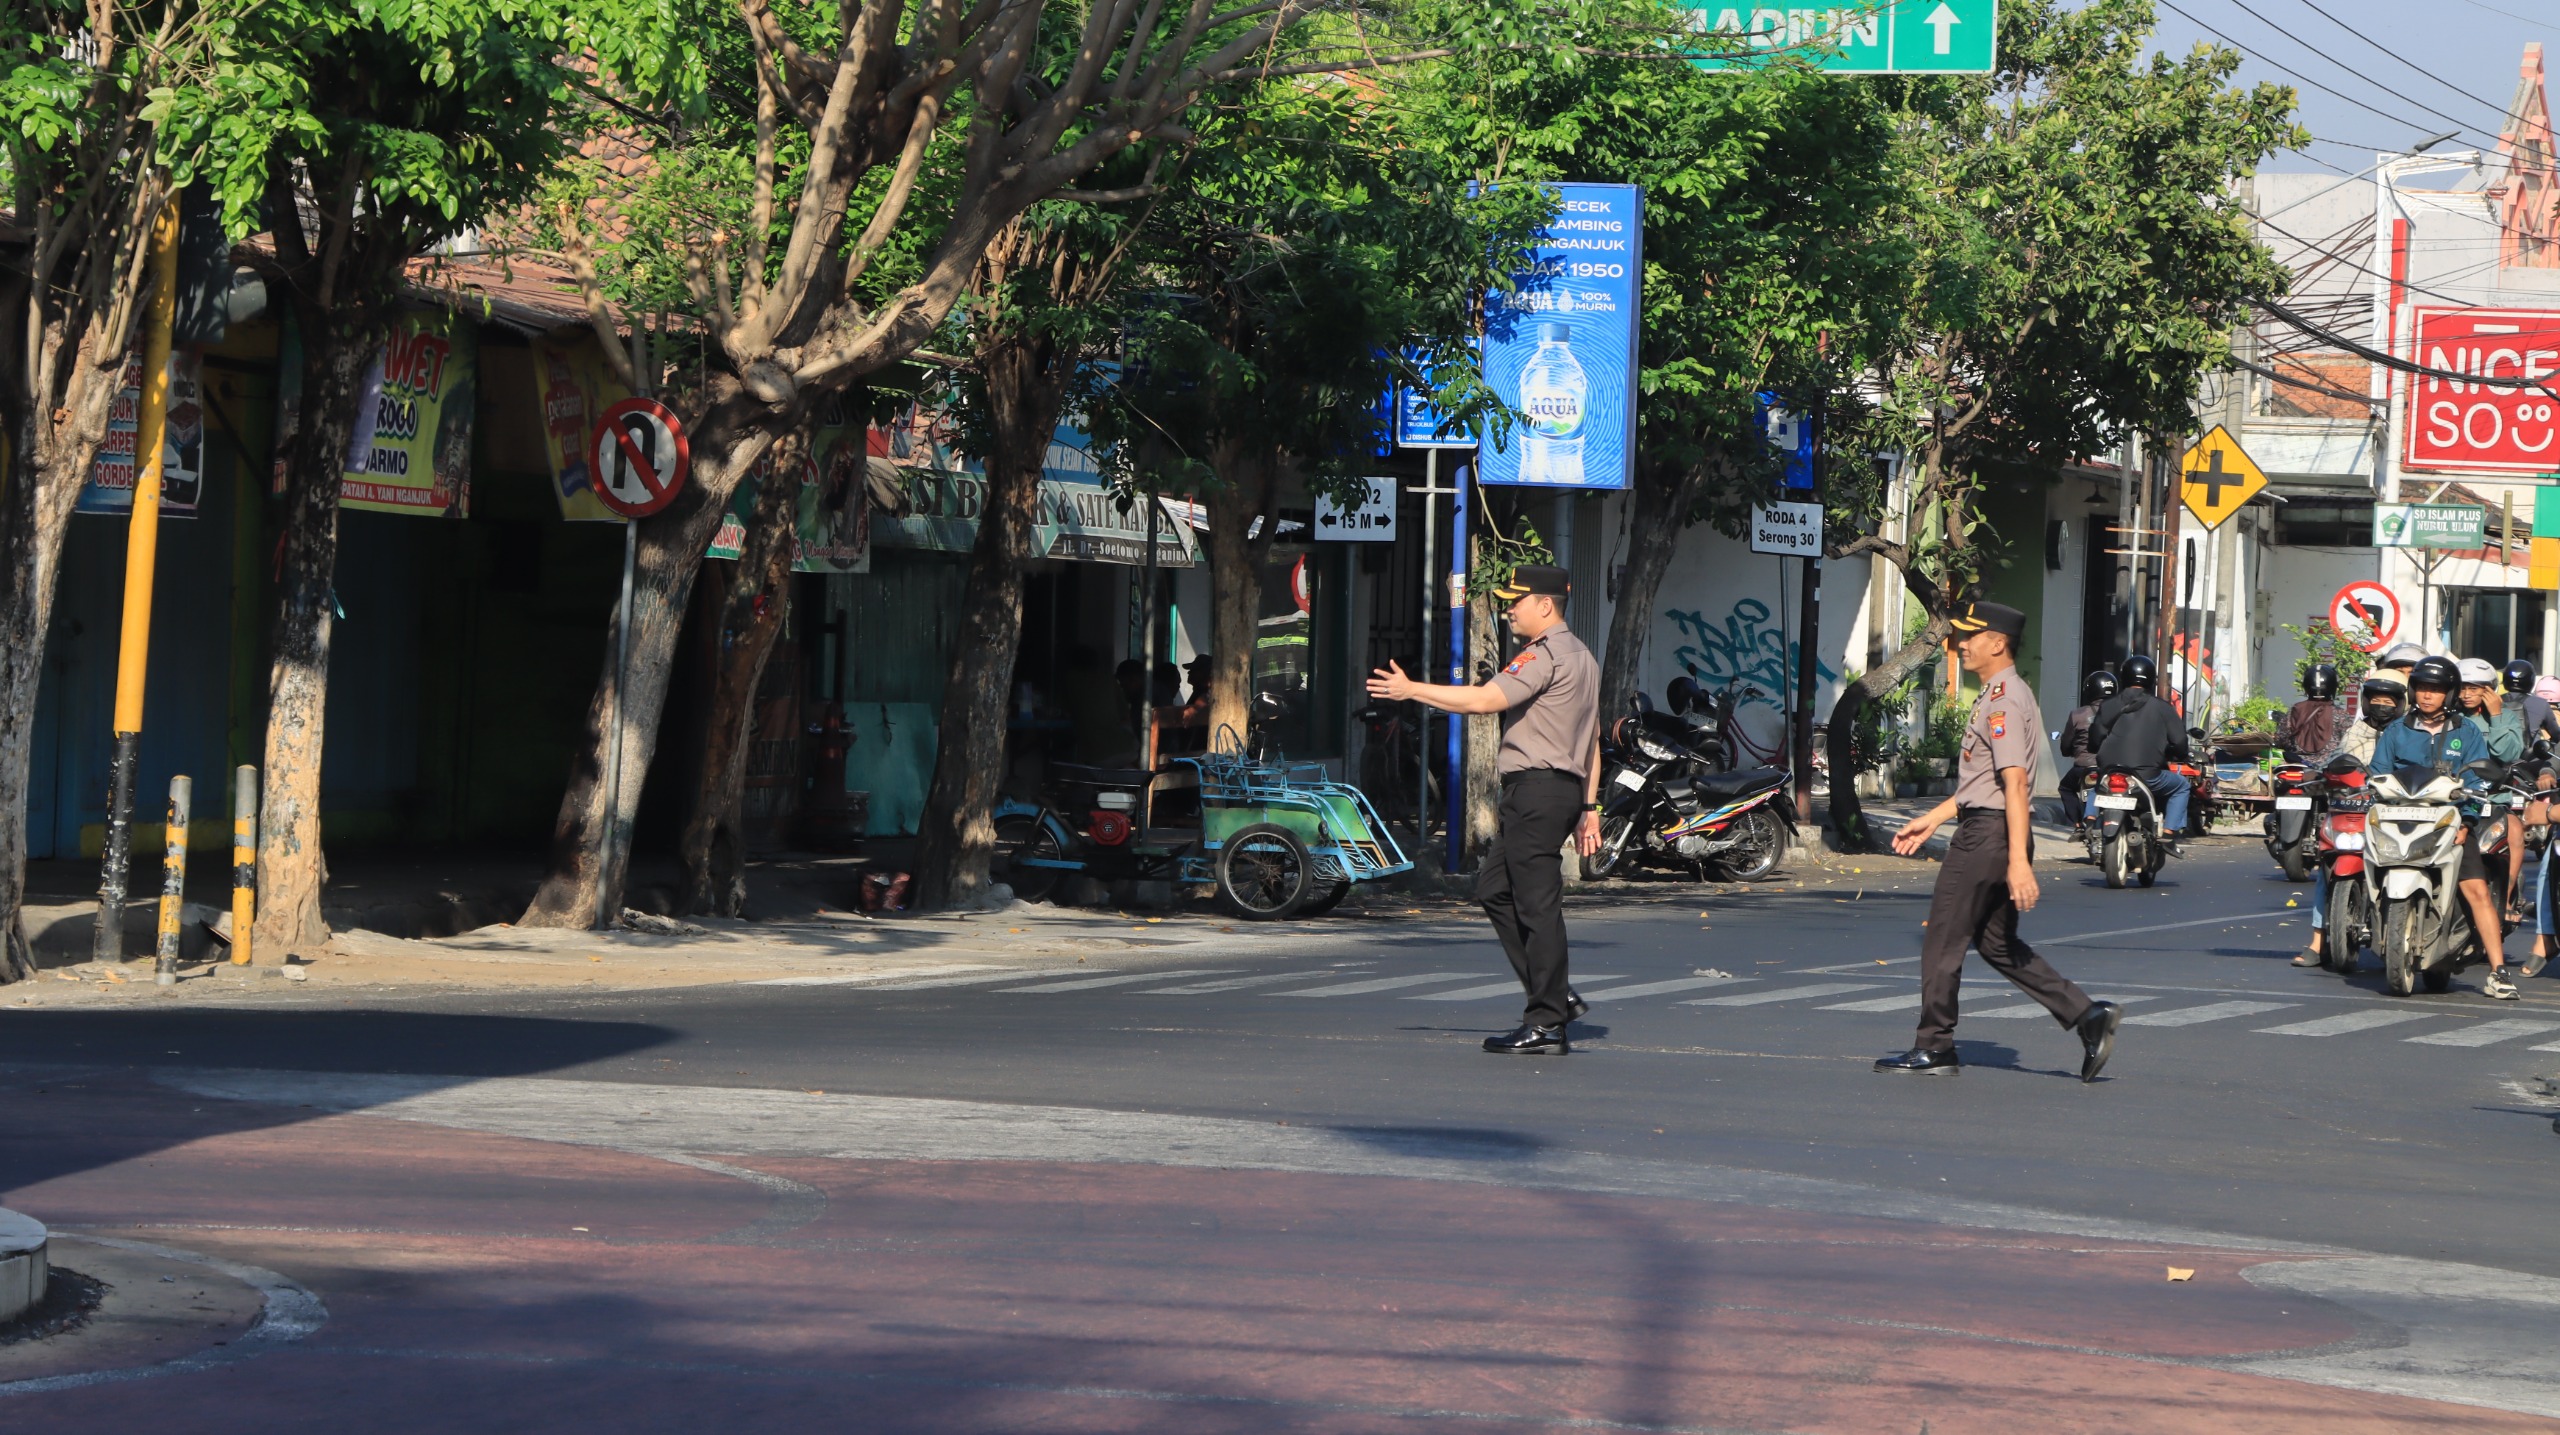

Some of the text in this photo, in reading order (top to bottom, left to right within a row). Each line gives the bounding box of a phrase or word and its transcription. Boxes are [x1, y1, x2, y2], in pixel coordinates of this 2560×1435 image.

[1557, 201, 1611, 212] ECEK
[1500, 261, 1624, 277] EJAK 1950
[1501, 291, 1554, 313] AQUA
[1581, 293, 1611, 301] 100%
[1576, 303, 1616, 311] MURNI
[2429, 346, 2559, 396] NICE
[1529, 397, 1578, 419] AQUA
[2427, 400, 2503, 449] SO
[366, 449, 408, 475] ARMO
[341, 482, 367, 499] PATAN
[376, 486, 394, 501] YANI
[396, 488, 432, 505] NGANJUK
[1076, 493, 1114, 529] SATE
[1765, 510, 1807, 526] RODA 4
[2414, 509, 2482, 521] SD ISLAM PLUS
[1340, 513, 1371, 529] 15 M
[2417, 521, 2478, 532] NURUL ULUM
[1759, 528, 1796, 548] Serong
[1080, 541, 1095, 554] Dr.
[1100, 541, 1140, 559] Soetomo
